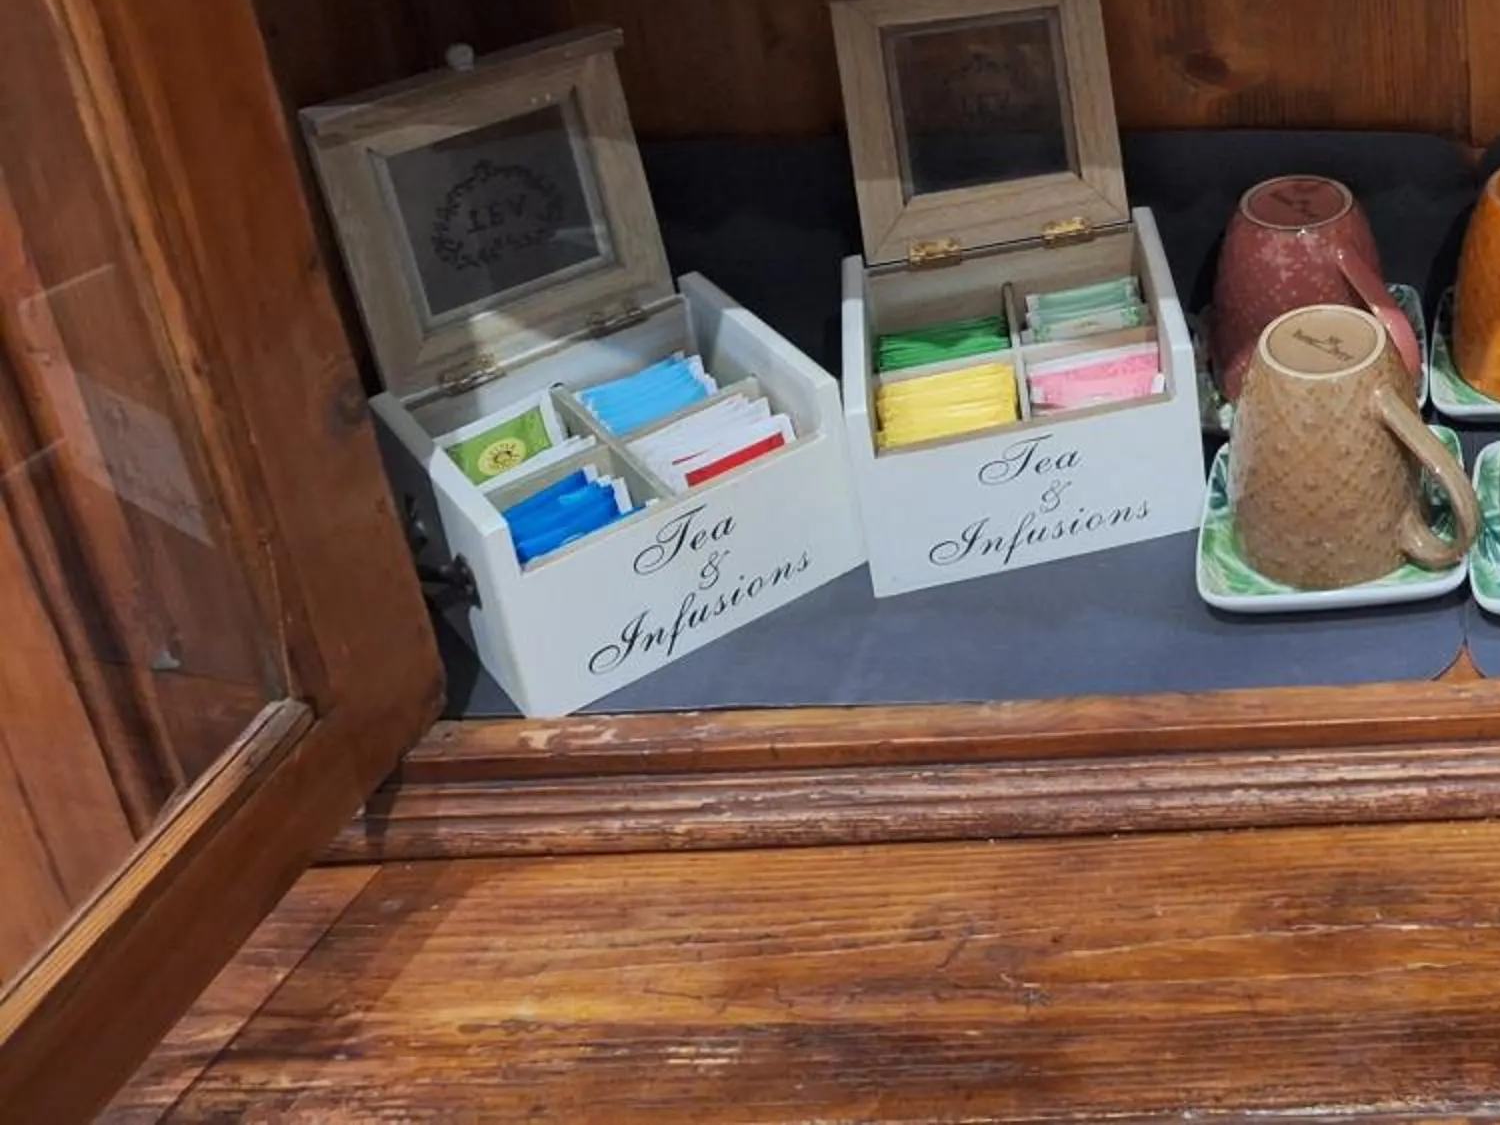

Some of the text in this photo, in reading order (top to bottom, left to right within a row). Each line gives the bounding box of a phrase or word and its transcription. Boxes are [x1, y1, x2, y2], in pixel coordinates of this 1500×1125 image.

[978, 434, 1082, 486] Tea
[1039, 479, 1072, 513] &
[633, 504, 737, 575] Tea
[929, 499, 1151, 566] Infusions
[699, 549, 732, 590] &
[588, 548, 811, 675] Infusions
